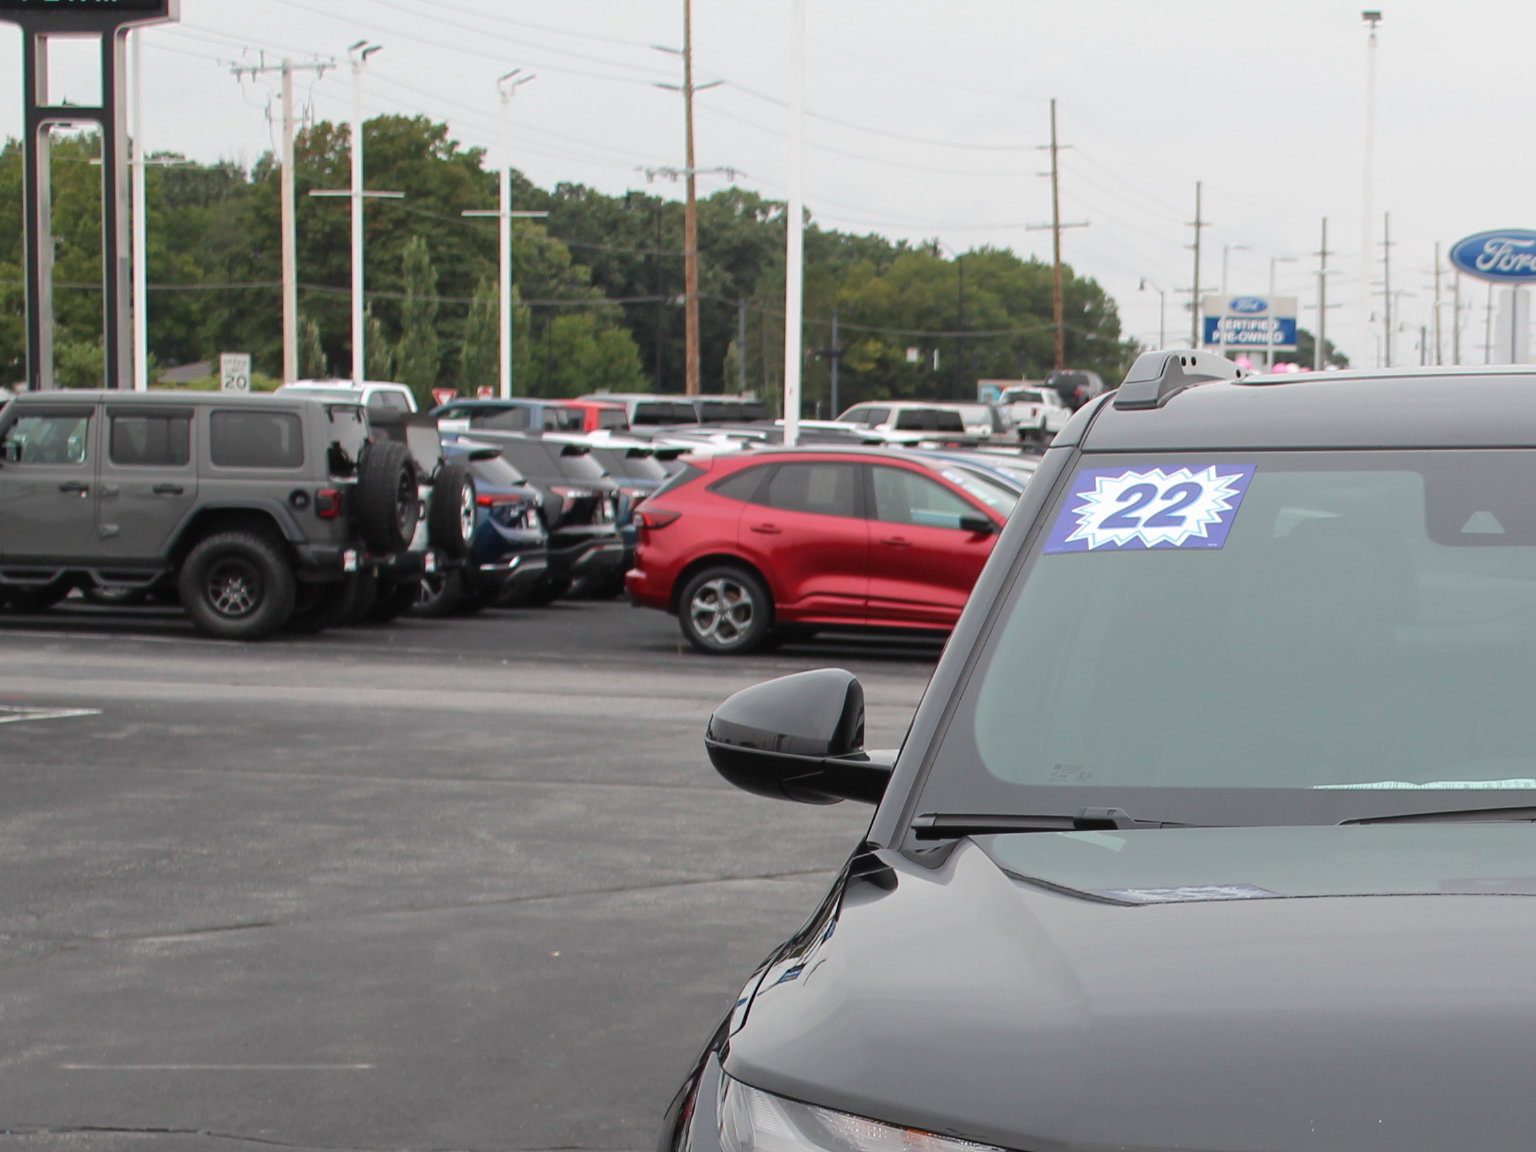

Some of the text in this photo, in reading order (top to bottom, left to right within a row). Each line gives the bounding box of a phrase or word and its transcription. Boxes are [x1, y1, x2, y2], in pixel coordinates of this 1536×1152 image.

[1217, 318, 1279, 331] CERTIFIED
[225, 375, 247, 389] 20
[1097, 481, 1204, 530] 22
